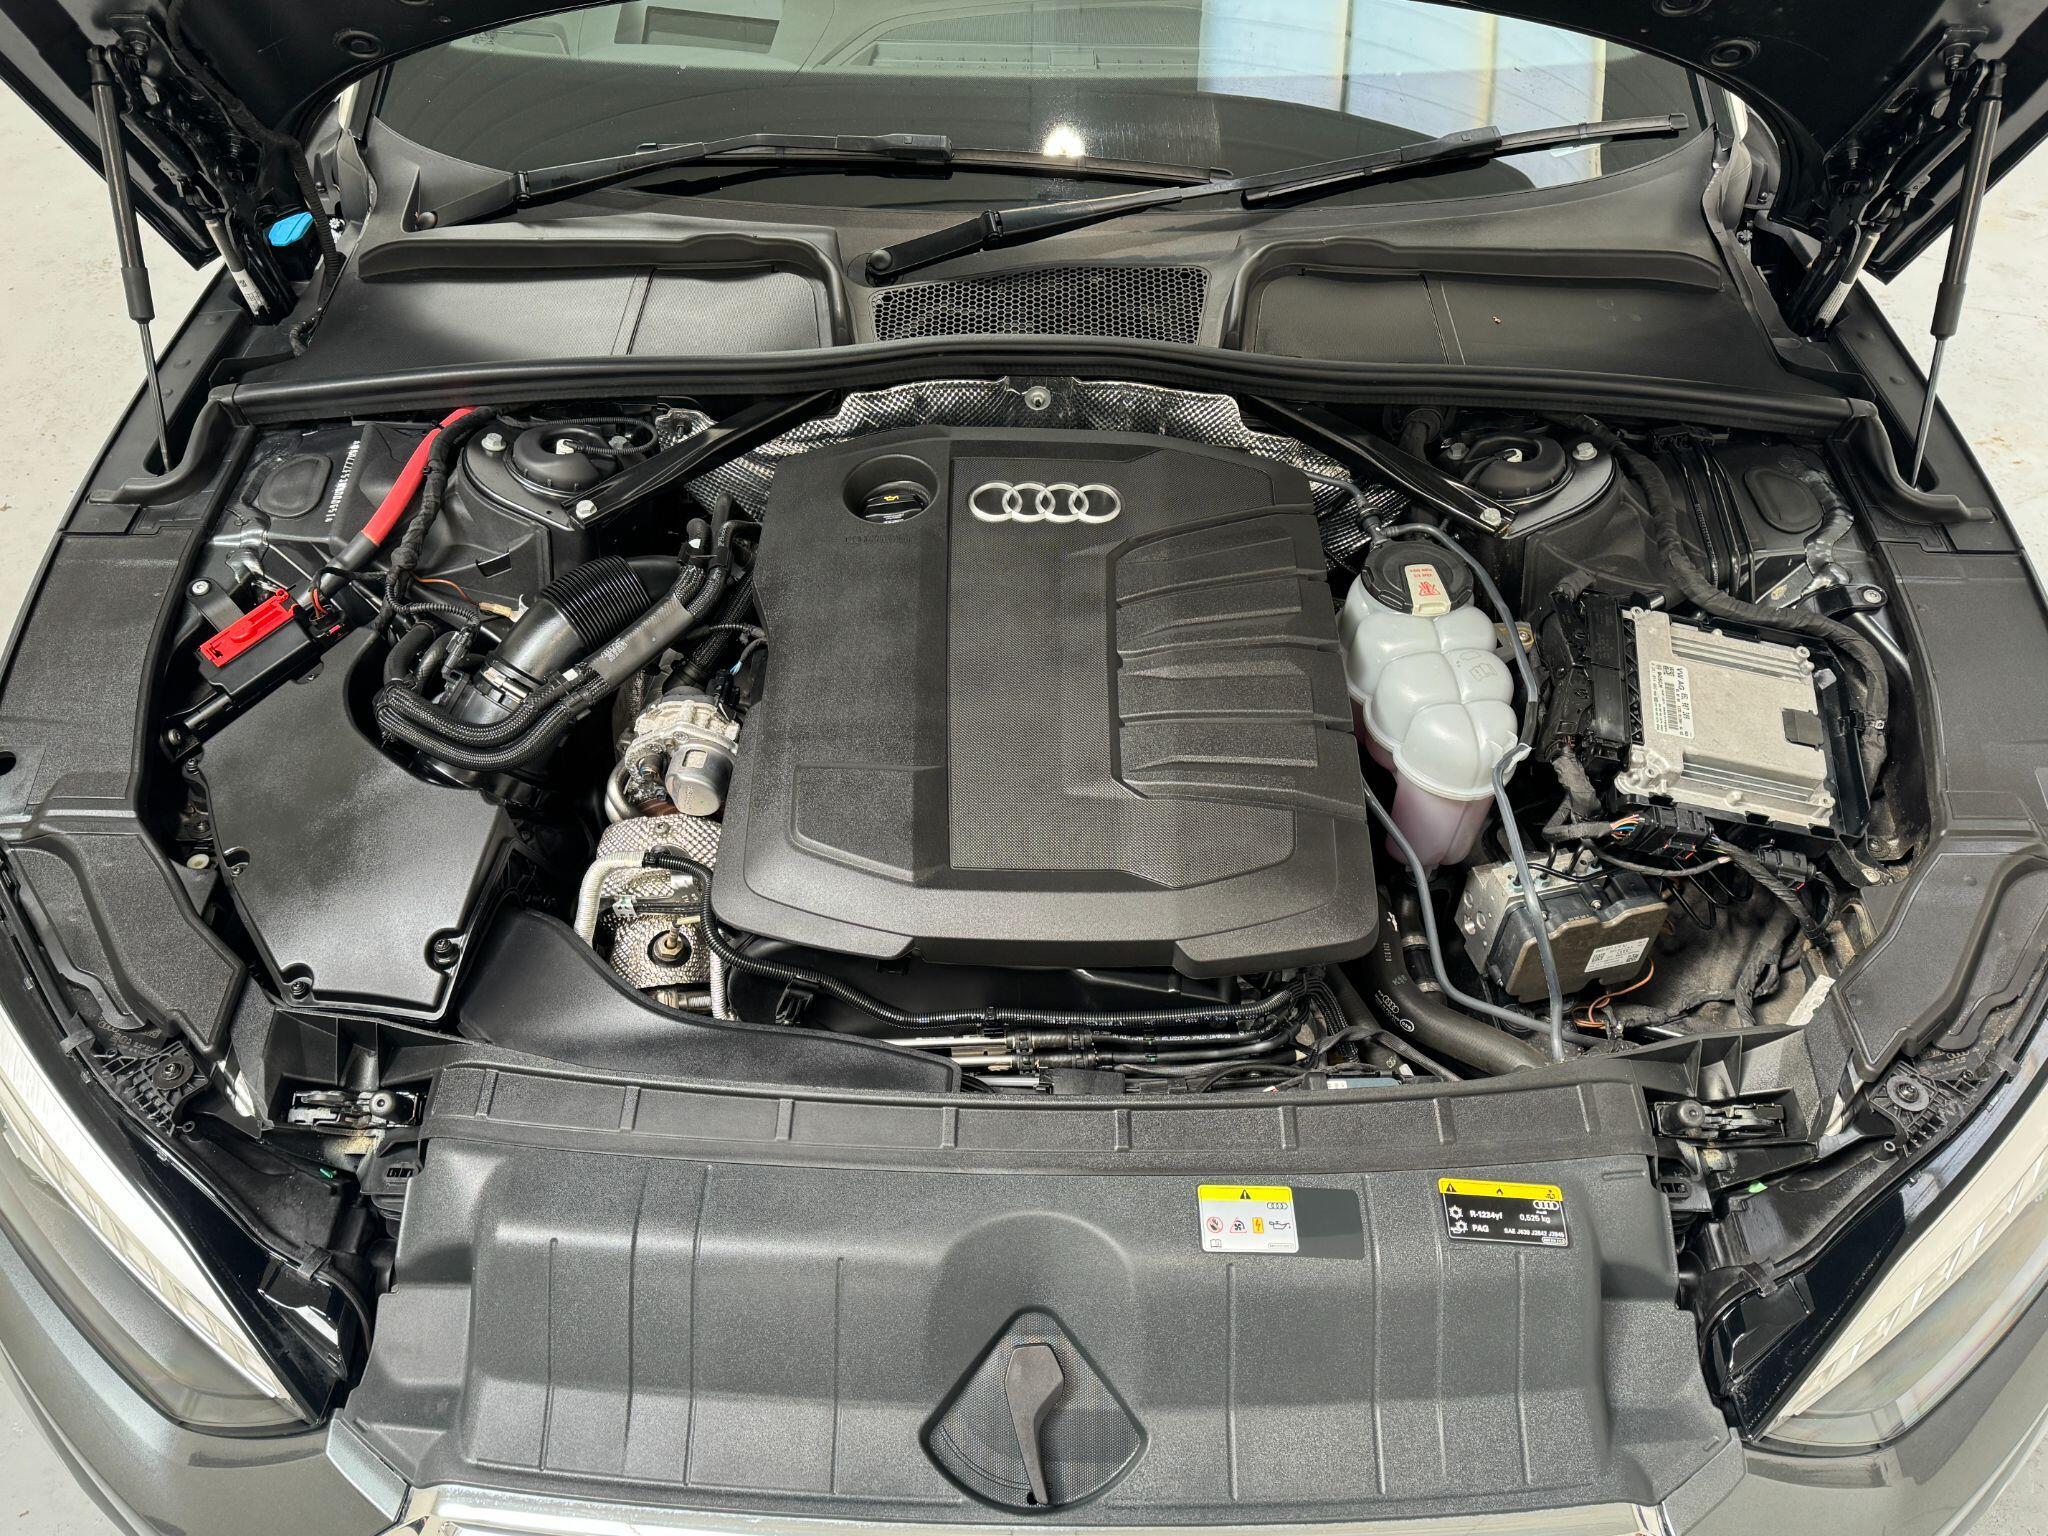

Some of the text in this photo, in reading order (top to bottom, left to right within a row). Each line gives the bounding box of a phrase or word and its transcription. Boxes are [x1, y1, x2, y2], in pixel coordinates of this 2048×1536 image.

[1470, 1210, 1551, 1224] R-1234yf 0,525 kg
[1472, 1224, 1489, 1232] PAG
